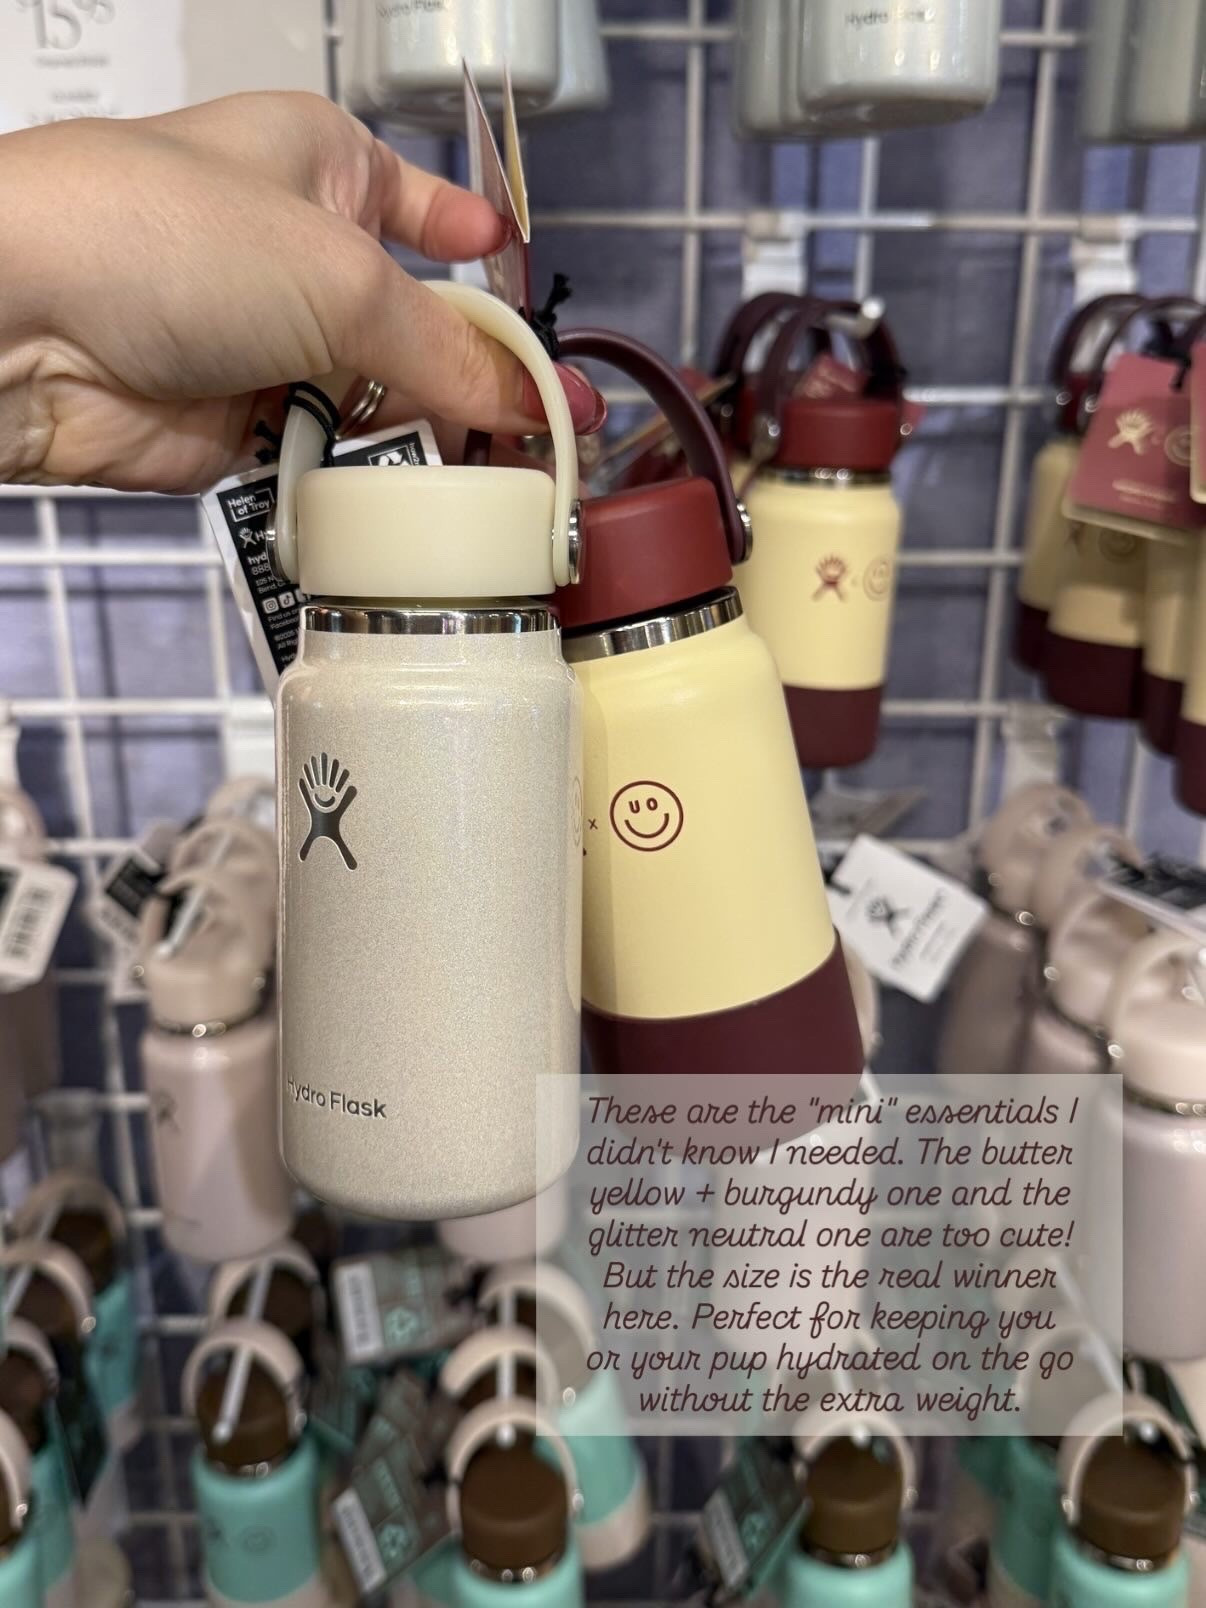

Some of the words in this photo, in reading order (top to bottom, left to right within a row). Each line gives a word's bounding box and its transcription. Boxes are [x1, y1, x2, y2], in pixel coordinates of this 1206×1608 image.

[227, 495, 256, 509] Helen
[237, 504, 249, 515] of
[248, 500, 270, 512] Troy
[285, 1073, 326, 1107] Hydro
[328, 1090, 387, 1119] Flask
